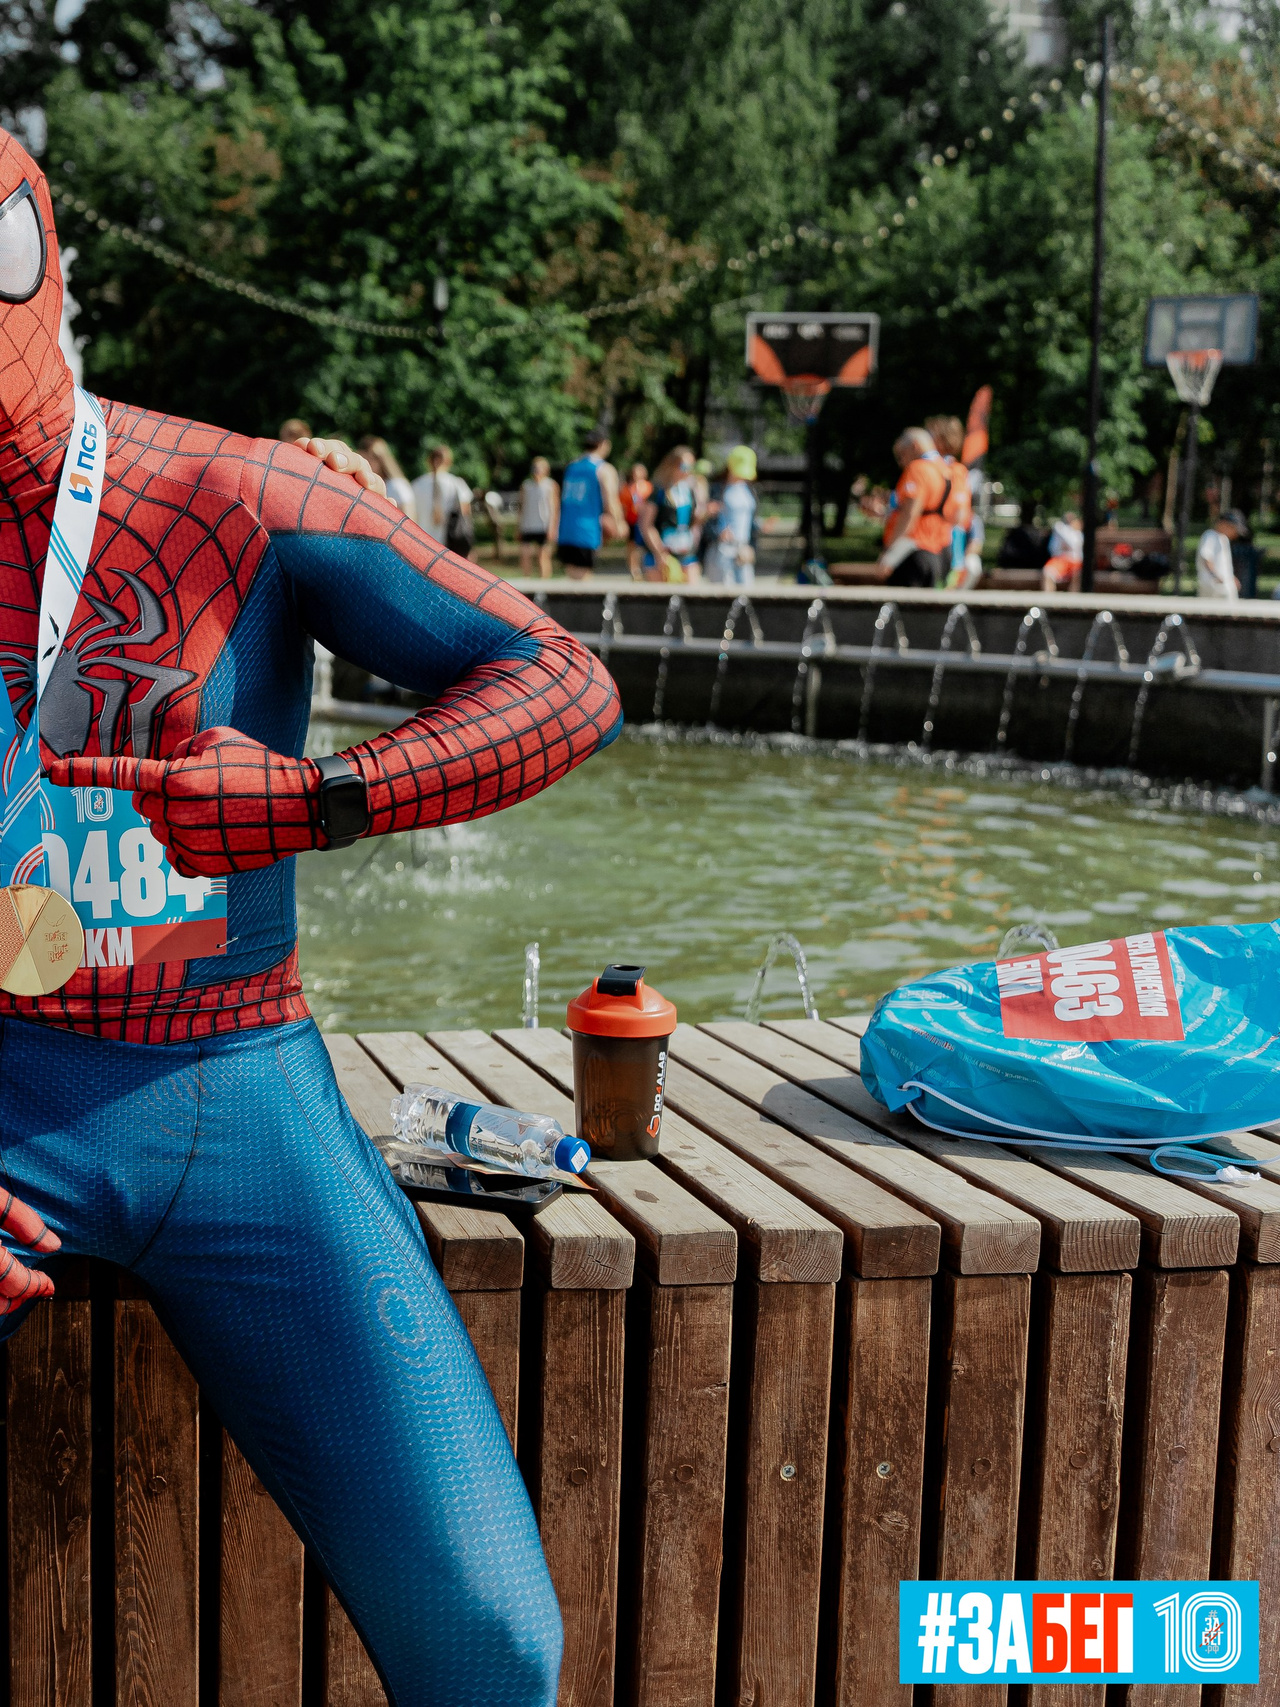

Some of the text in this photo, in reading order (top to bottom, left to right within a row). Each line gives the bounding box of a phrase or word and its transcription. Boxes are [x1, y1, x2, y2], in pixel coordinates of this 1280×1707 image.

[76, 421, 98, 471] ПСБ
[70, 786, 114, 823] 10
[83, 926, 135, 968] KM
[1046, 940, 1124, 1022] 0463
[1128, 955, 1169, 1017] ХРАНЕНИЯ
